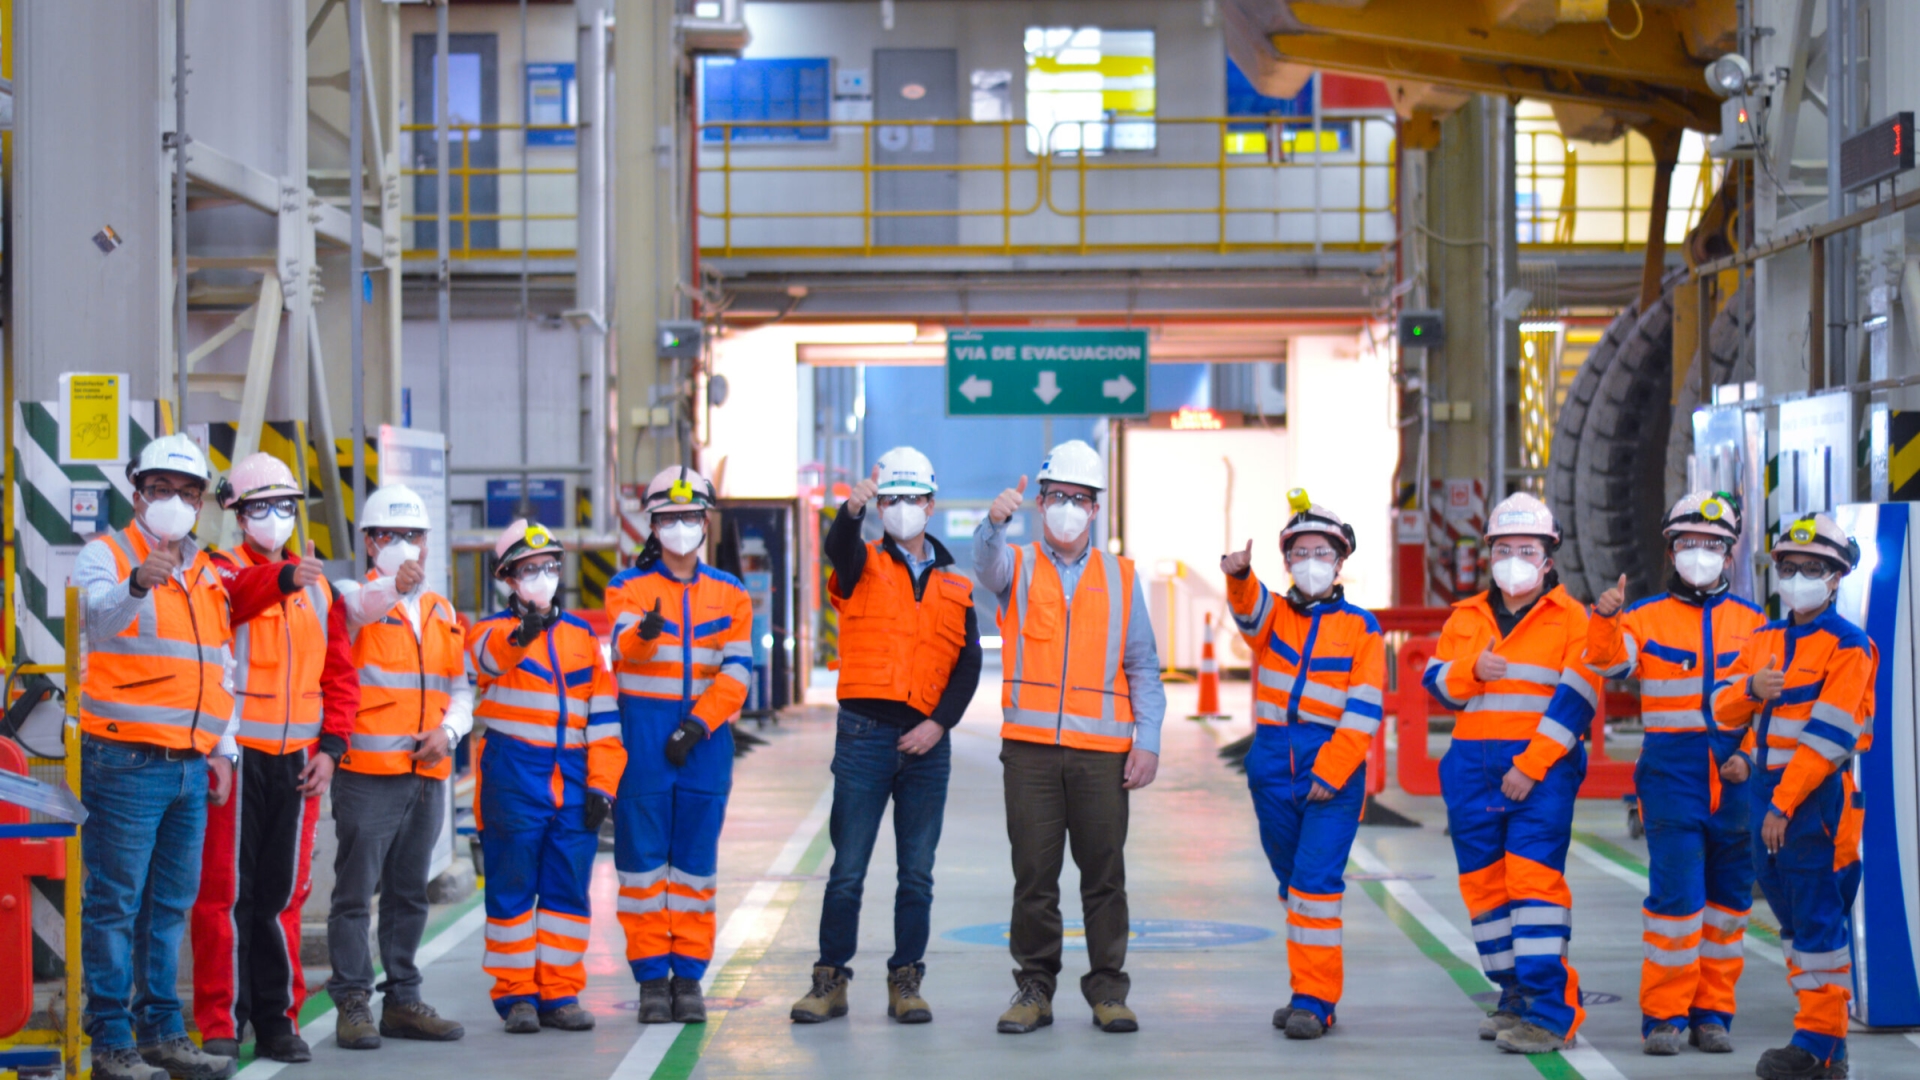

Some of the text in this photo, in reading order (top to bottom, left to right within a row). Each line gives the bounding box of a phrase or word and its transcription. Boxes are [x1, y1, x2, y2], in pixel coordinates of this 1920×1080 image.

[954, 345, 1142, 361] VIA DE EVACUACION
